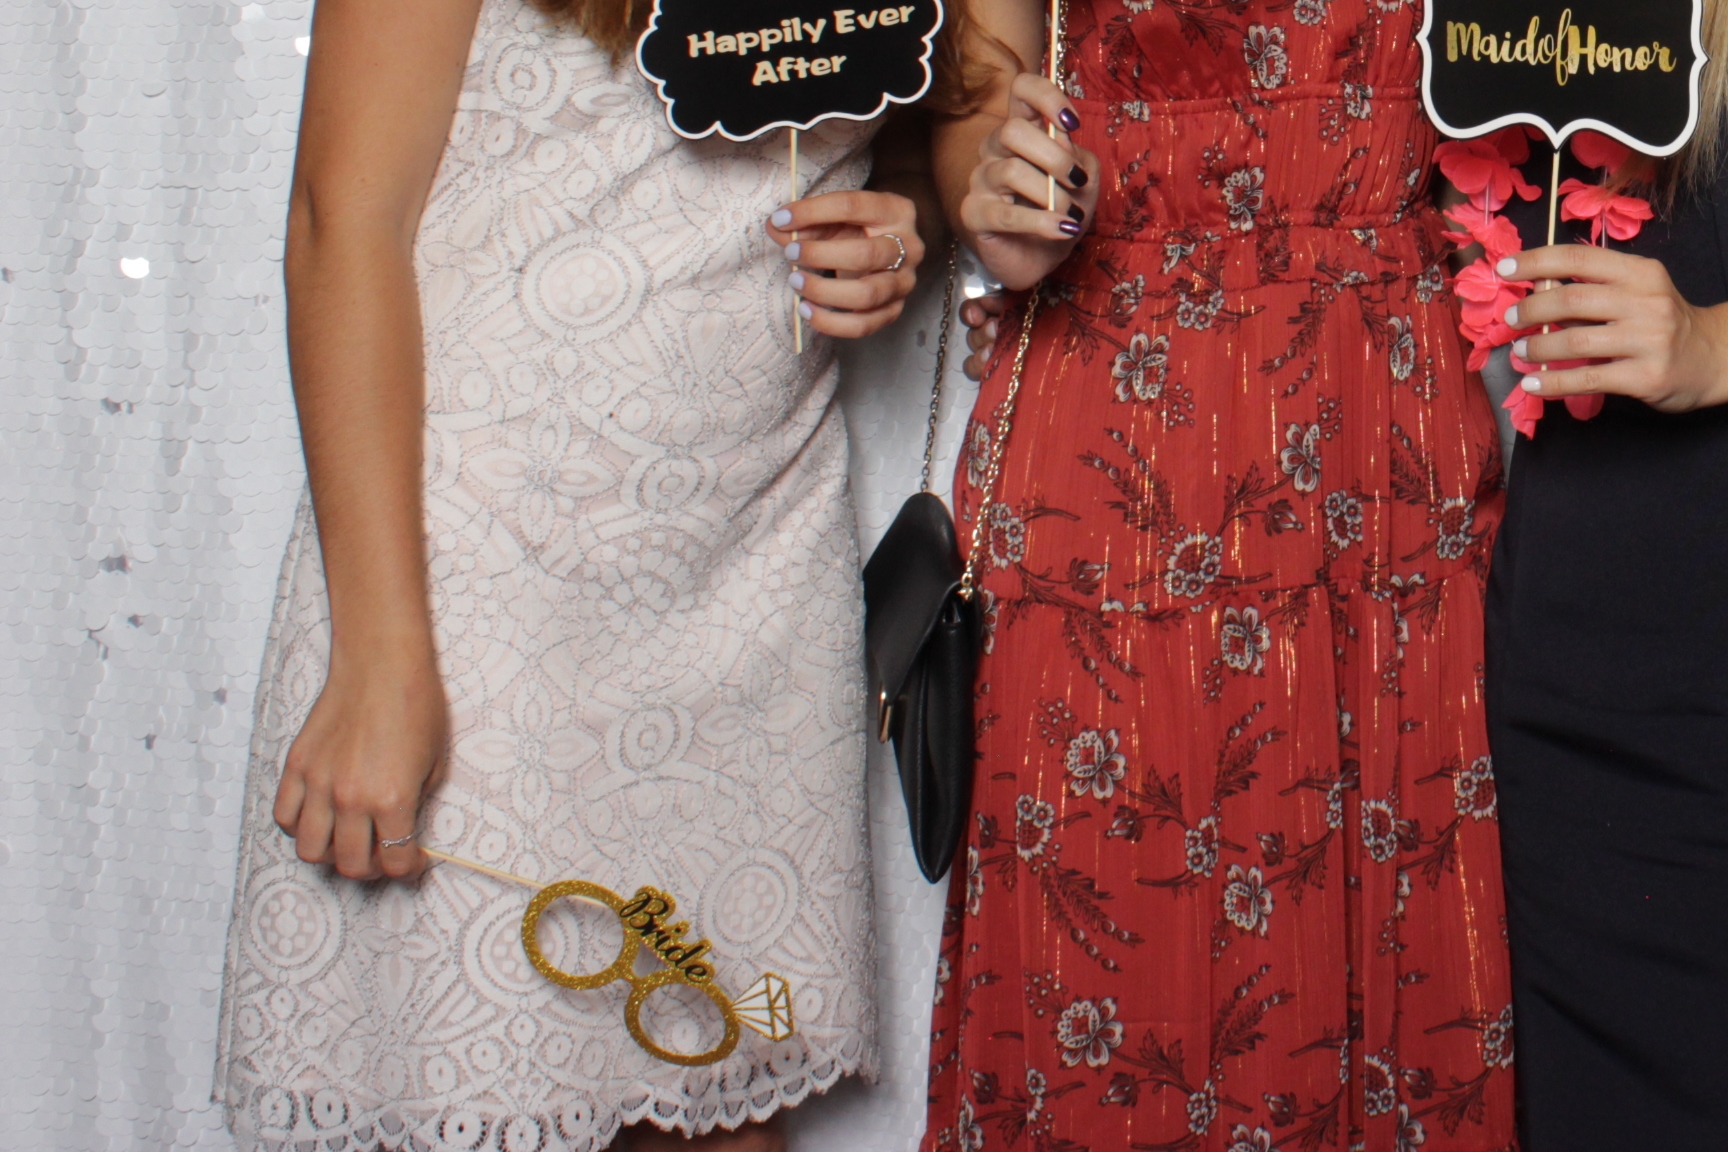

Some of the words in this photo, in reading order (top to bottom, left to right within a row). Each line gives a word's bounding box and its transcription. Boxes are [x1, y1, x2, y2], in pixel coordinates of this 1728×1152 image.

[687, 16, 827, 59] Happily
[833, 5, 916, 35] Ever
[751, 54, 847, 87] After
[619, 891, 708, 983] Bride
